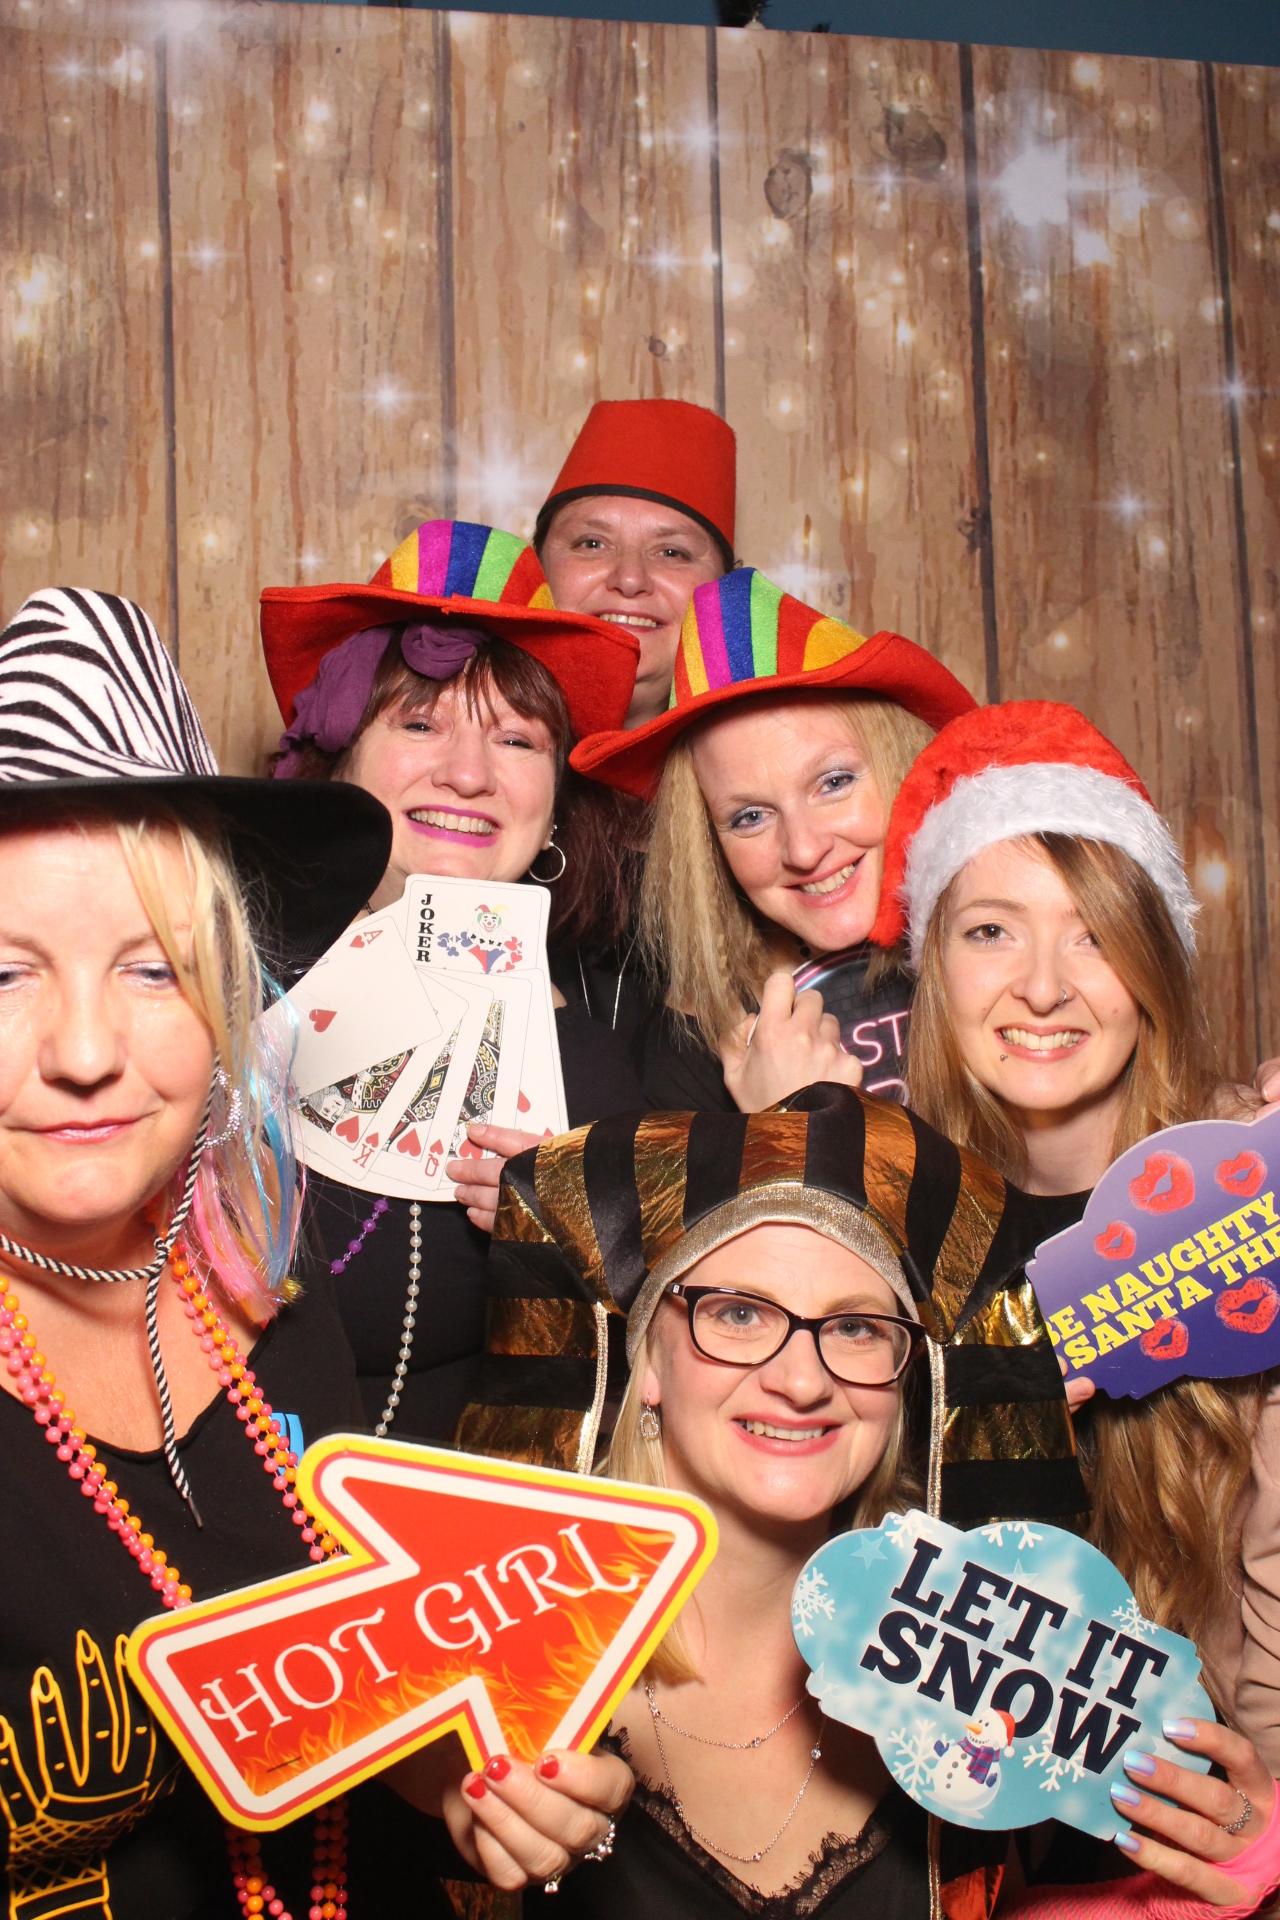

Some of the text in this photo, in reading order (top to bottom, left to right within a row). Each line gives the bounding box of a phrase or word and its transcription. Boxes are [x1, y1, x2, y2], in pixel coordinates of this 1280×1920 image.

[363, 930, 384, 945] A
[416, 893, 435, 962] JOKER
[352, 1143, 375, 1168] K
[424, 1153, 439, 1177] Q
[1080, 1191, 1280, 1322] NAUGHTY
[1064, 1275, 1213, 1370] SANTA
[199, 1522, 640, 1743] HOT GIRL
[890, 1537, 1170, 1710] LET IT
[859, 1610, 1142, 1775] SNOW
